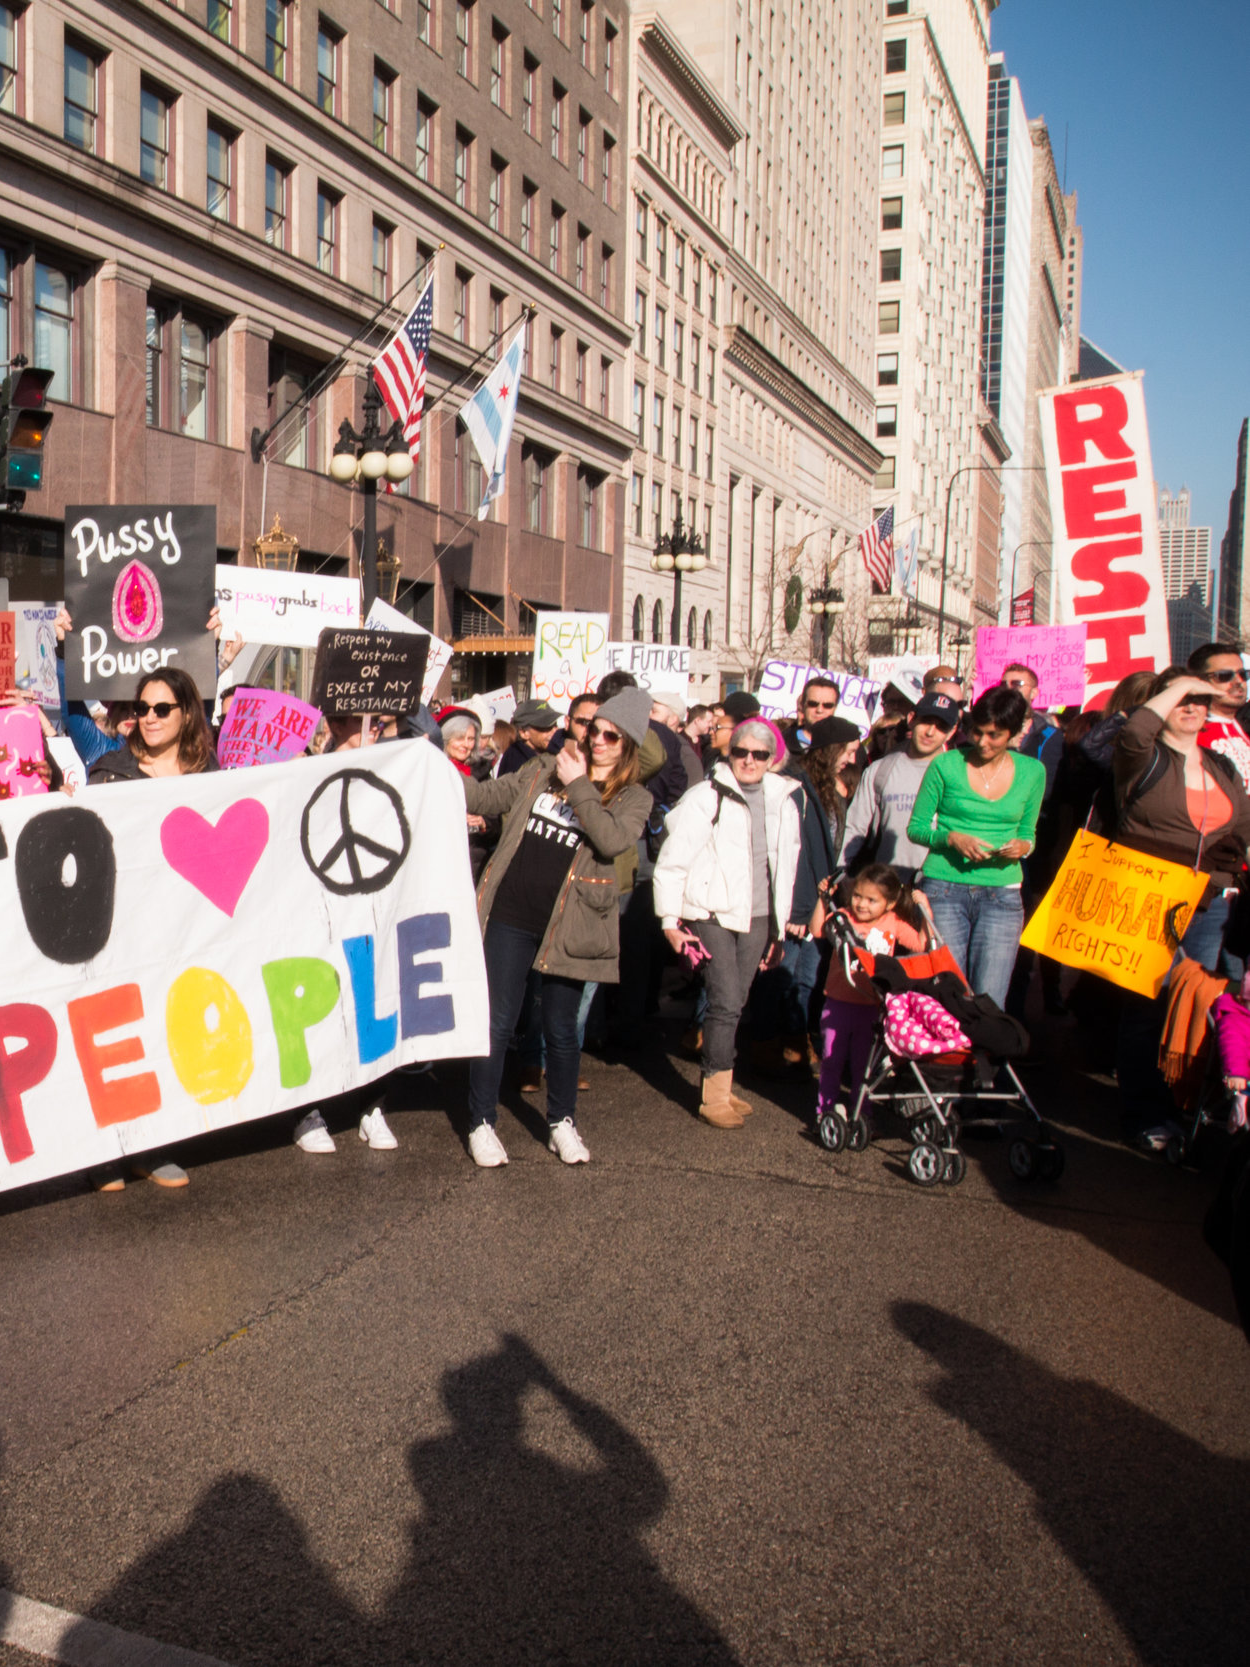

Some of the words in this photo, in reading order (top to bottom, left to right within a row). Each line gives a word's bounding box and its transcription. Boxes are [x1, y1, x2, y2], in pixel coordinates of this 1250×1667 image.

[71, 511, 181, 577] Pussy
[334, 633, 370, 650] Respect
[539, 621, 605, 664] READ
[1001, 630, 1038, 648] Trump
[81, 624, 178, 683] Power
[351, 650, 408, 662] existence
[630, 645, 690, 673] FUTURE
[1027, 653, 1047, 667] MY
[361, 664, 380, 678] OR
[532, 667, 597, 701] BOOK
[327, 681, 374, 697] EXPECT
[384, 680, 412, 693] MY
[336, 696, 415, 712] RESISTANCE!
[235, 698, 266, 718] WE
[271, 705, 313, 741] ARE
[227, 718, 290, 752] MANY
[1077, 842, 1094, 859] I
[1052, 868, 1192, 946] HUMAN
[1052, 923, 1143, 974] RIGHTS!!
